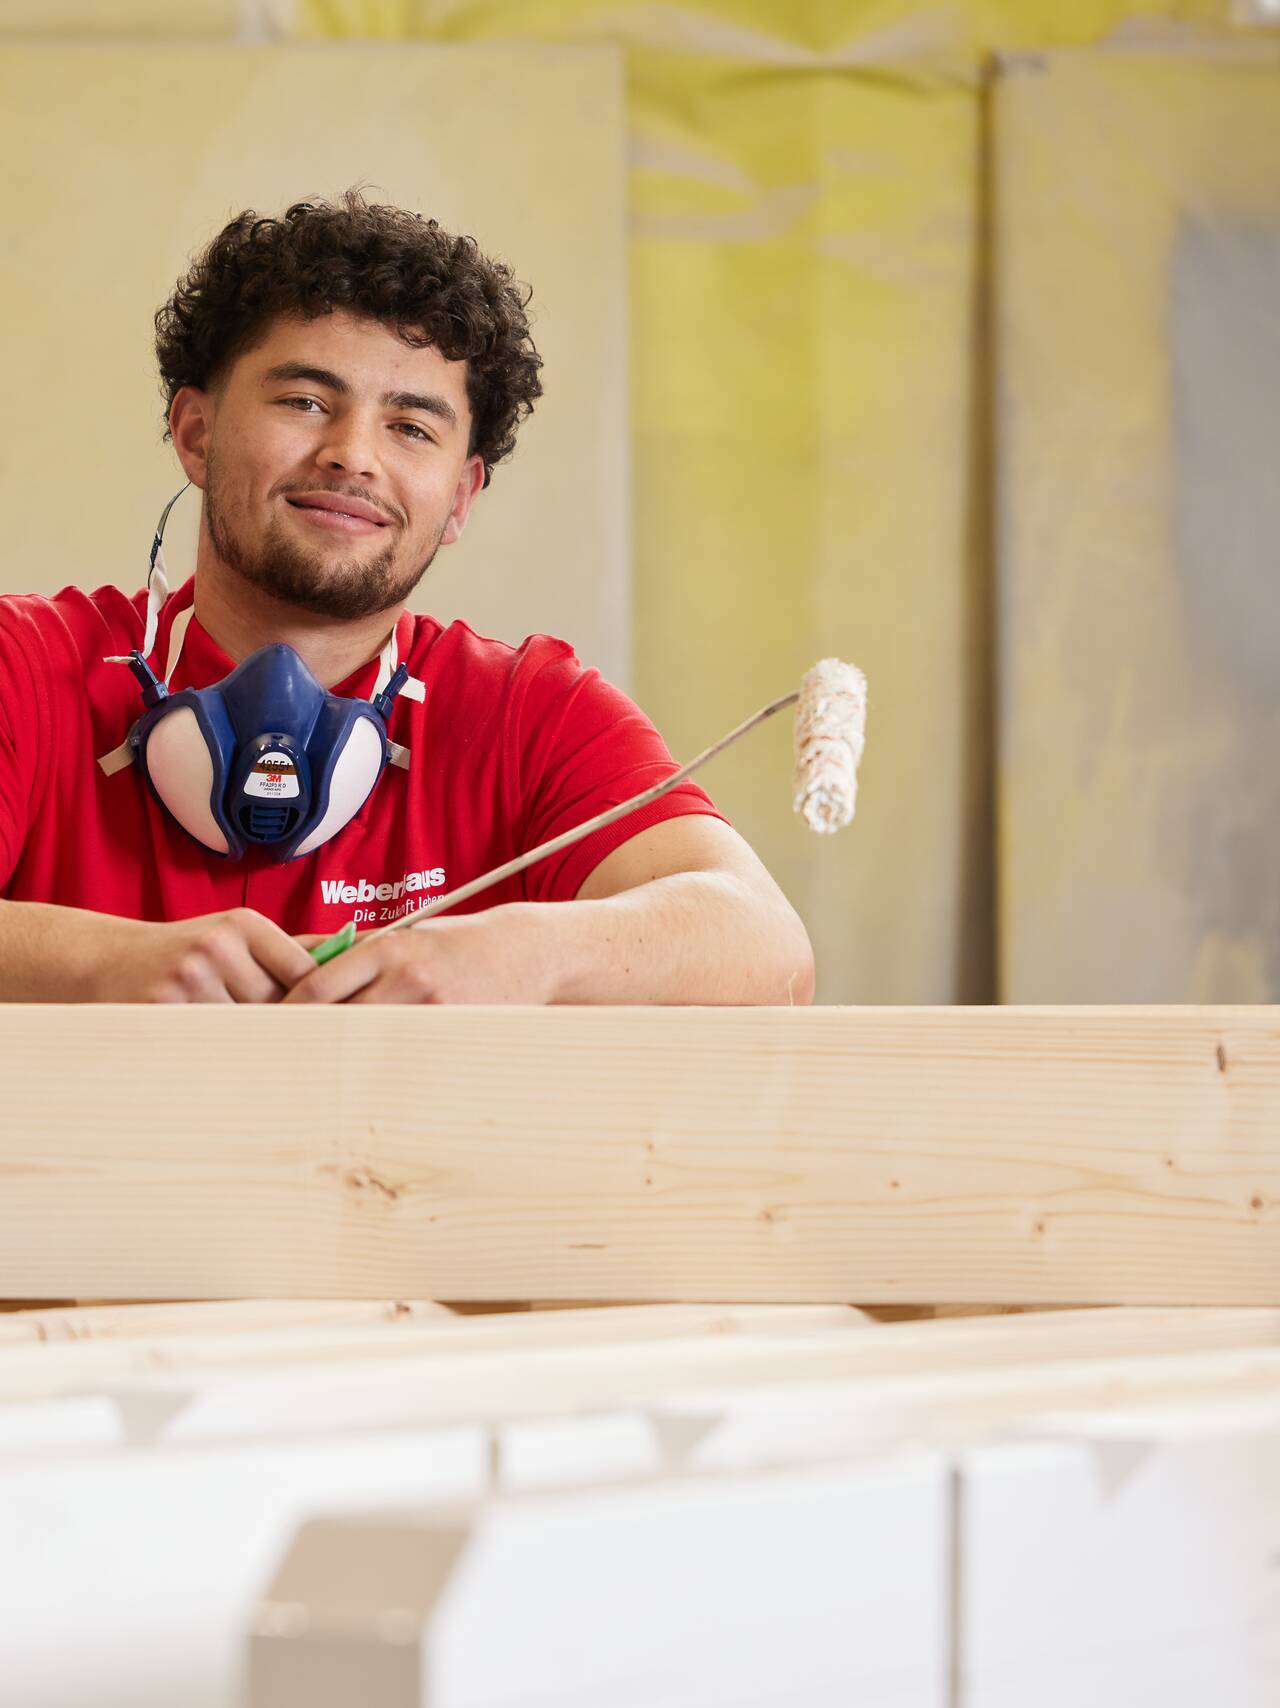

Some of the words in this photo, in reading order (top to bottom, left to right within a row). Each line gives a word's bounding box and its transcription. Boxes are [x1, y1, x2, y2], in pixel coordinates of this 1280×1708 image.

[266, 774, 281, 782] 3M
[321, 868, 445, 904] Weberaus
[354, 908, 376, 922] Die
